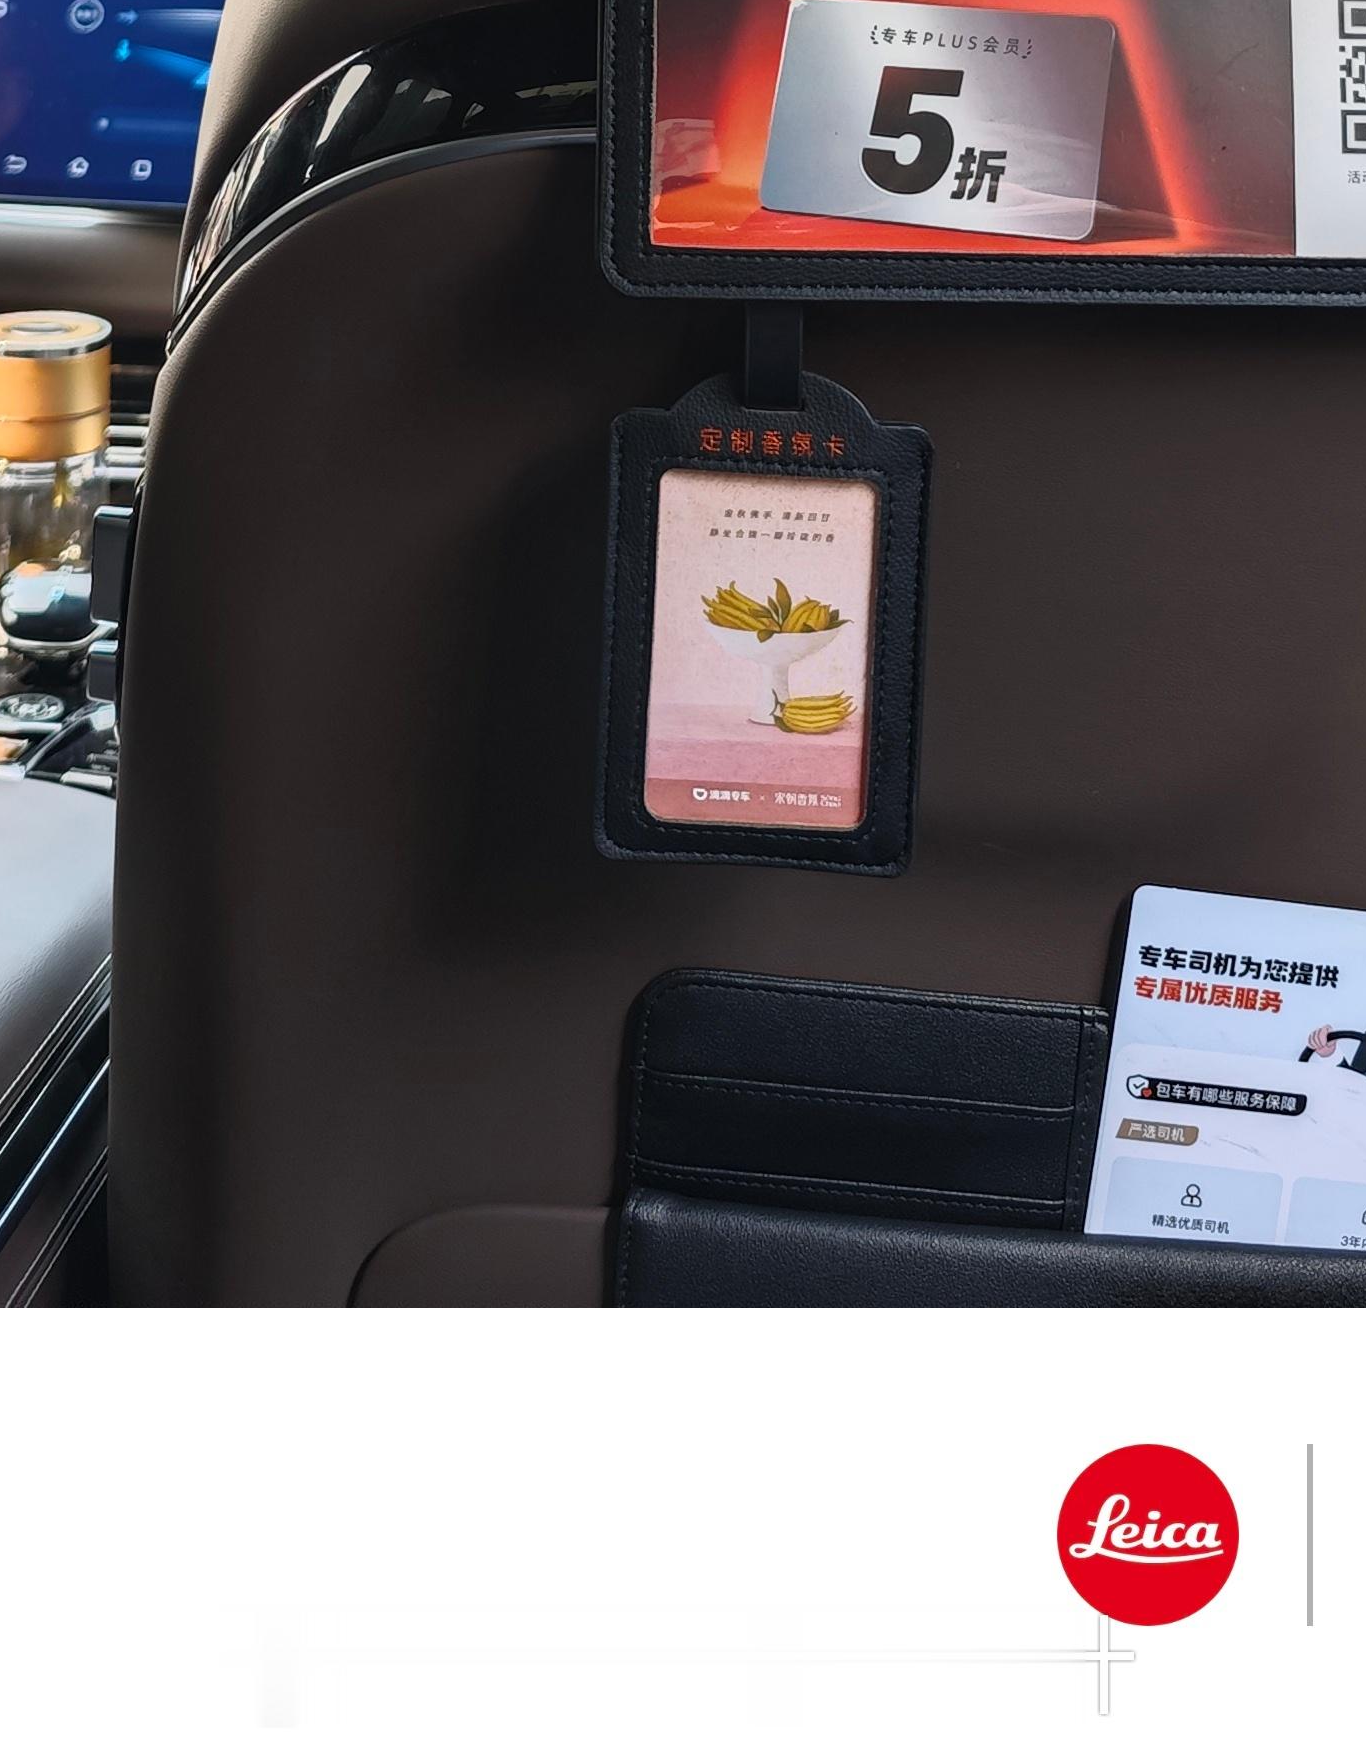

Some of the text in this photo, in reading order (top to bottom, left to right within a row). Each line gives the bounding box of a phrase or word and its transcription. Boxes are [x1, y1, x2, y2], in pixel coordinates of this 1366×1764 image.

[881, 27, 1020, 56] 专车PLUS会员
[861, 65, 1007, 203] 5折
[1138, 945, 1339, 988] 专车司机为您提供
[1134, 976, 1283, 1013] 专属优质服务
[1156, 1082, 1297, 1112] 包车有哪些服务保障
[1128, 1122, 1185, 1142] 严选司机
[1152, 1214, 1230, 1235] 精选优质司机
